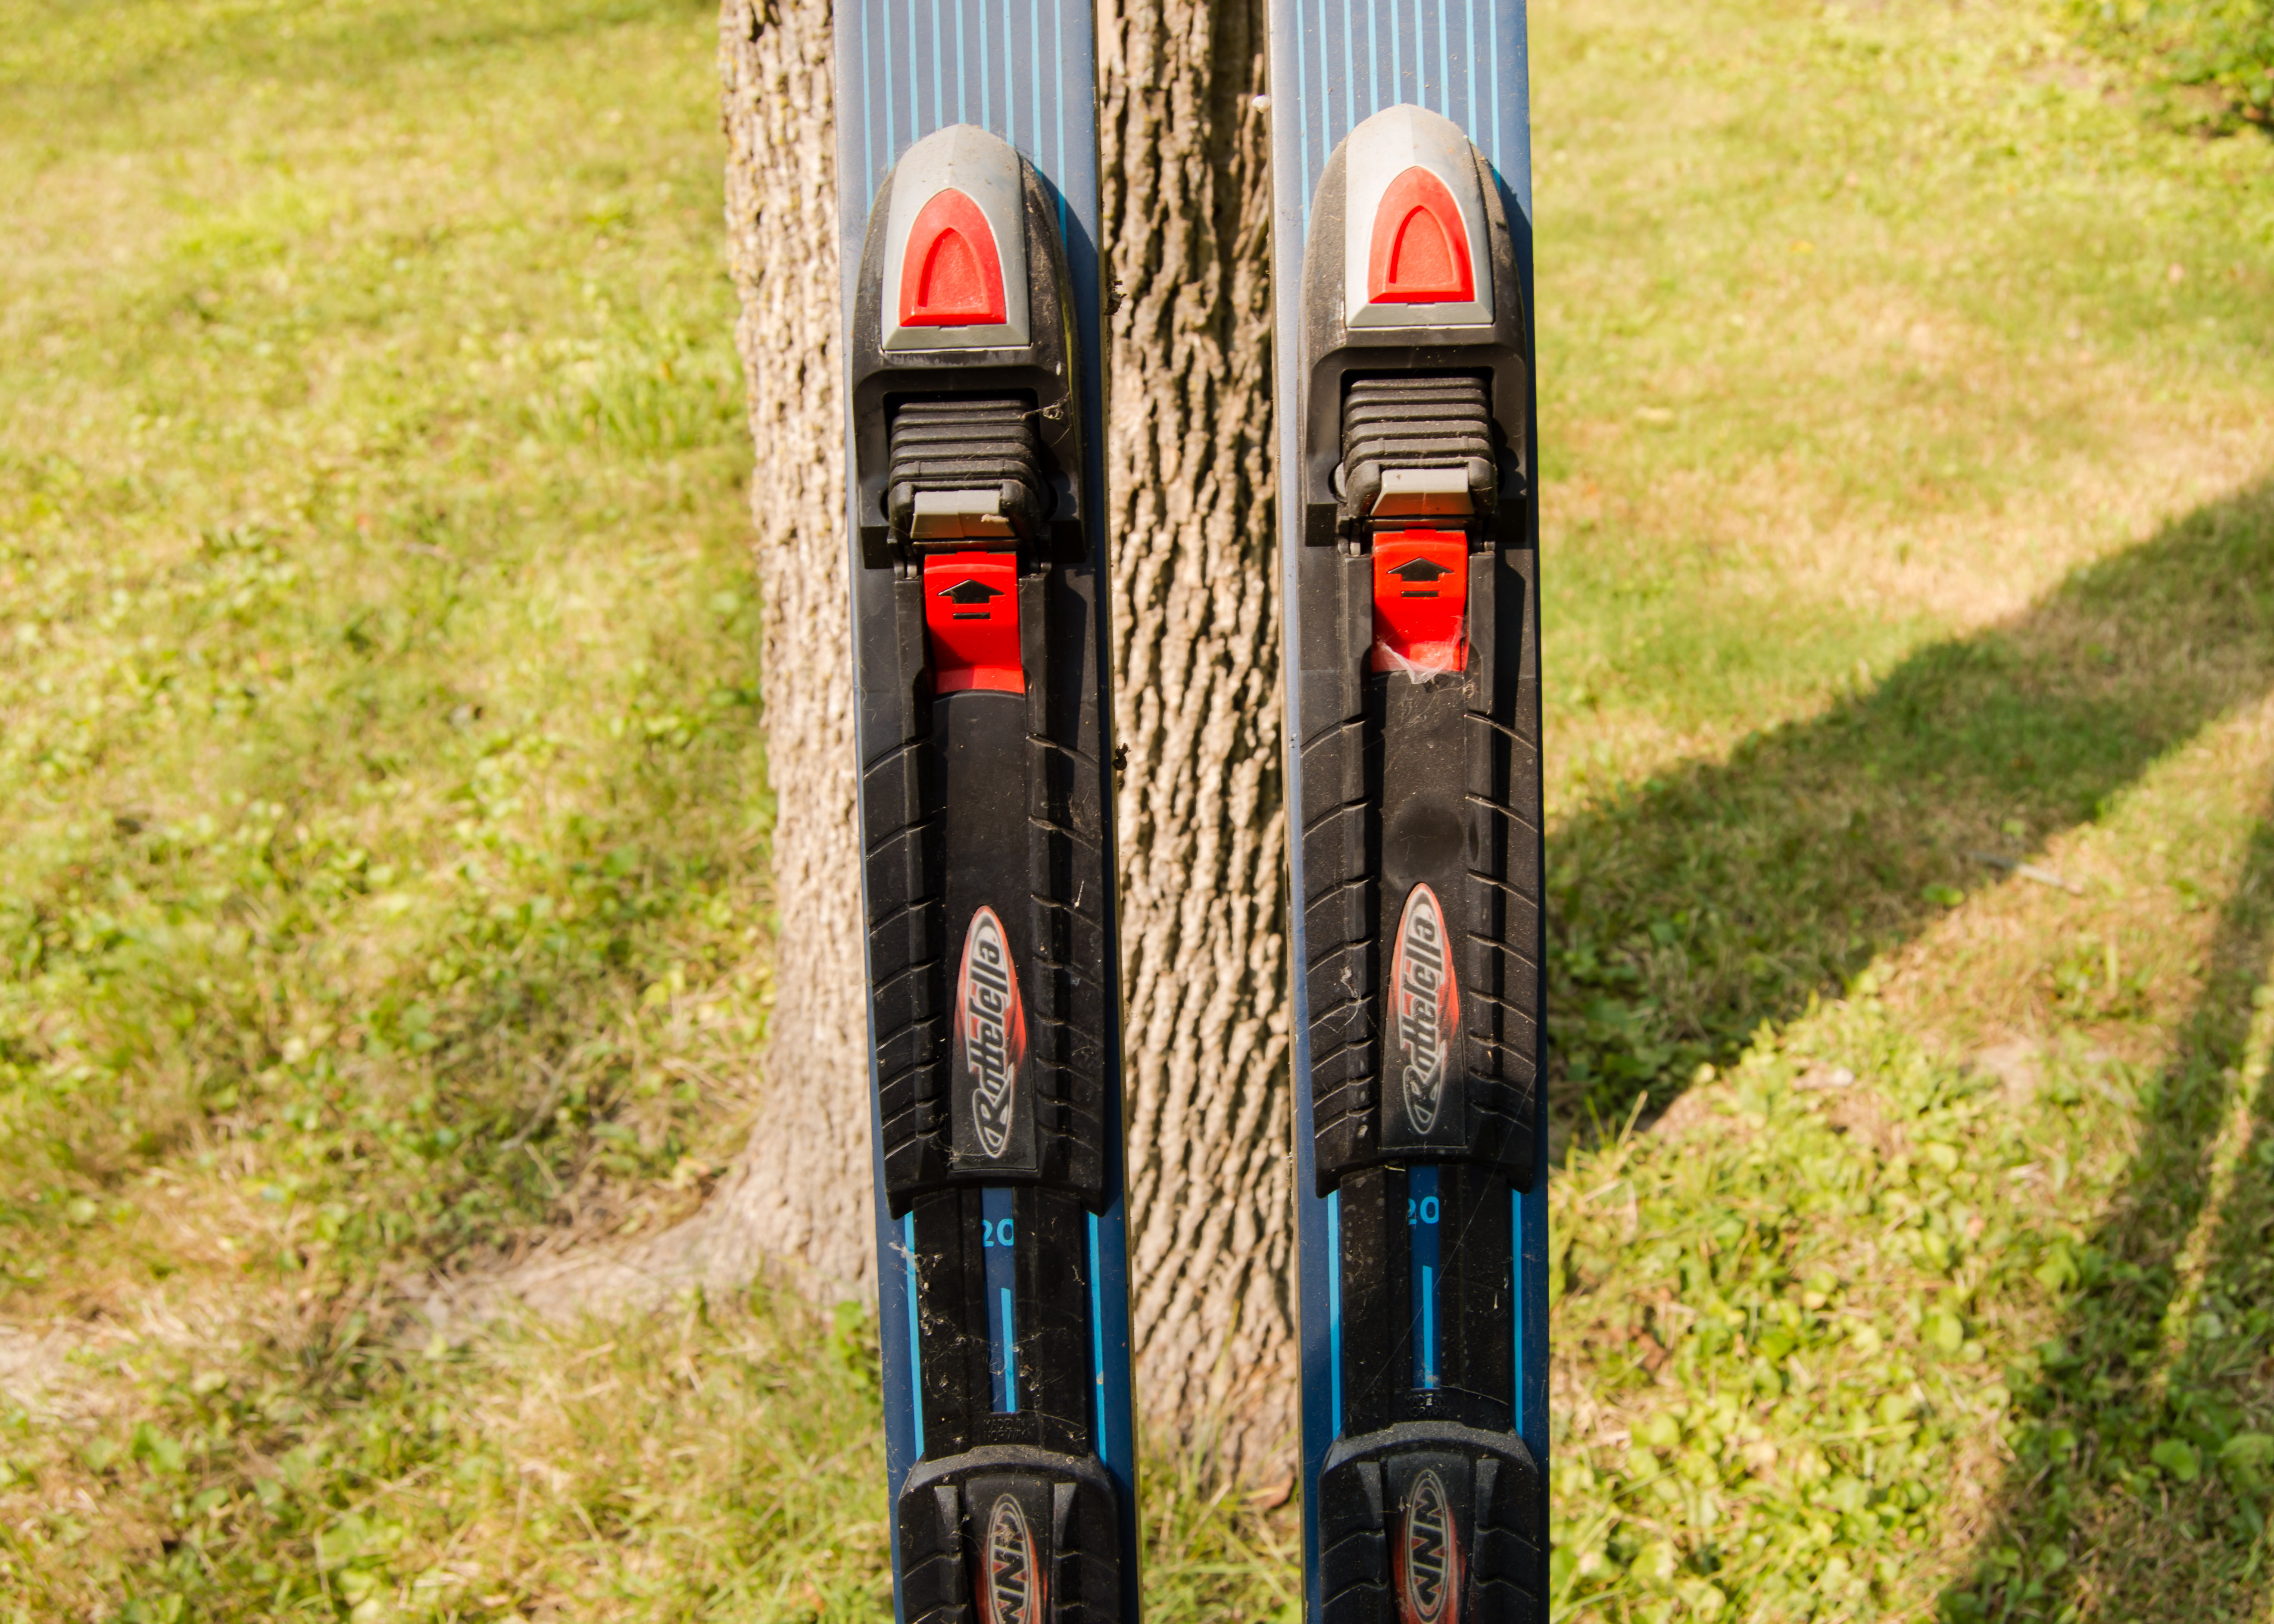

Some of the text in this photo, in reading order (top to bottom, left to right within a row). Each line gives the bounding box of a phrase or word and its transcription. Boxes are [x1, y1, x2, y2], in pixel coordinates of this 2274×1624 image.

[967, 912, 1014, 1158] Rottefella
[1399, 890, 1446, 1134] Rottefella
[992, 1510, 1027, 1624] NNN
[1409, 1485, 1446, 1608] NNN
